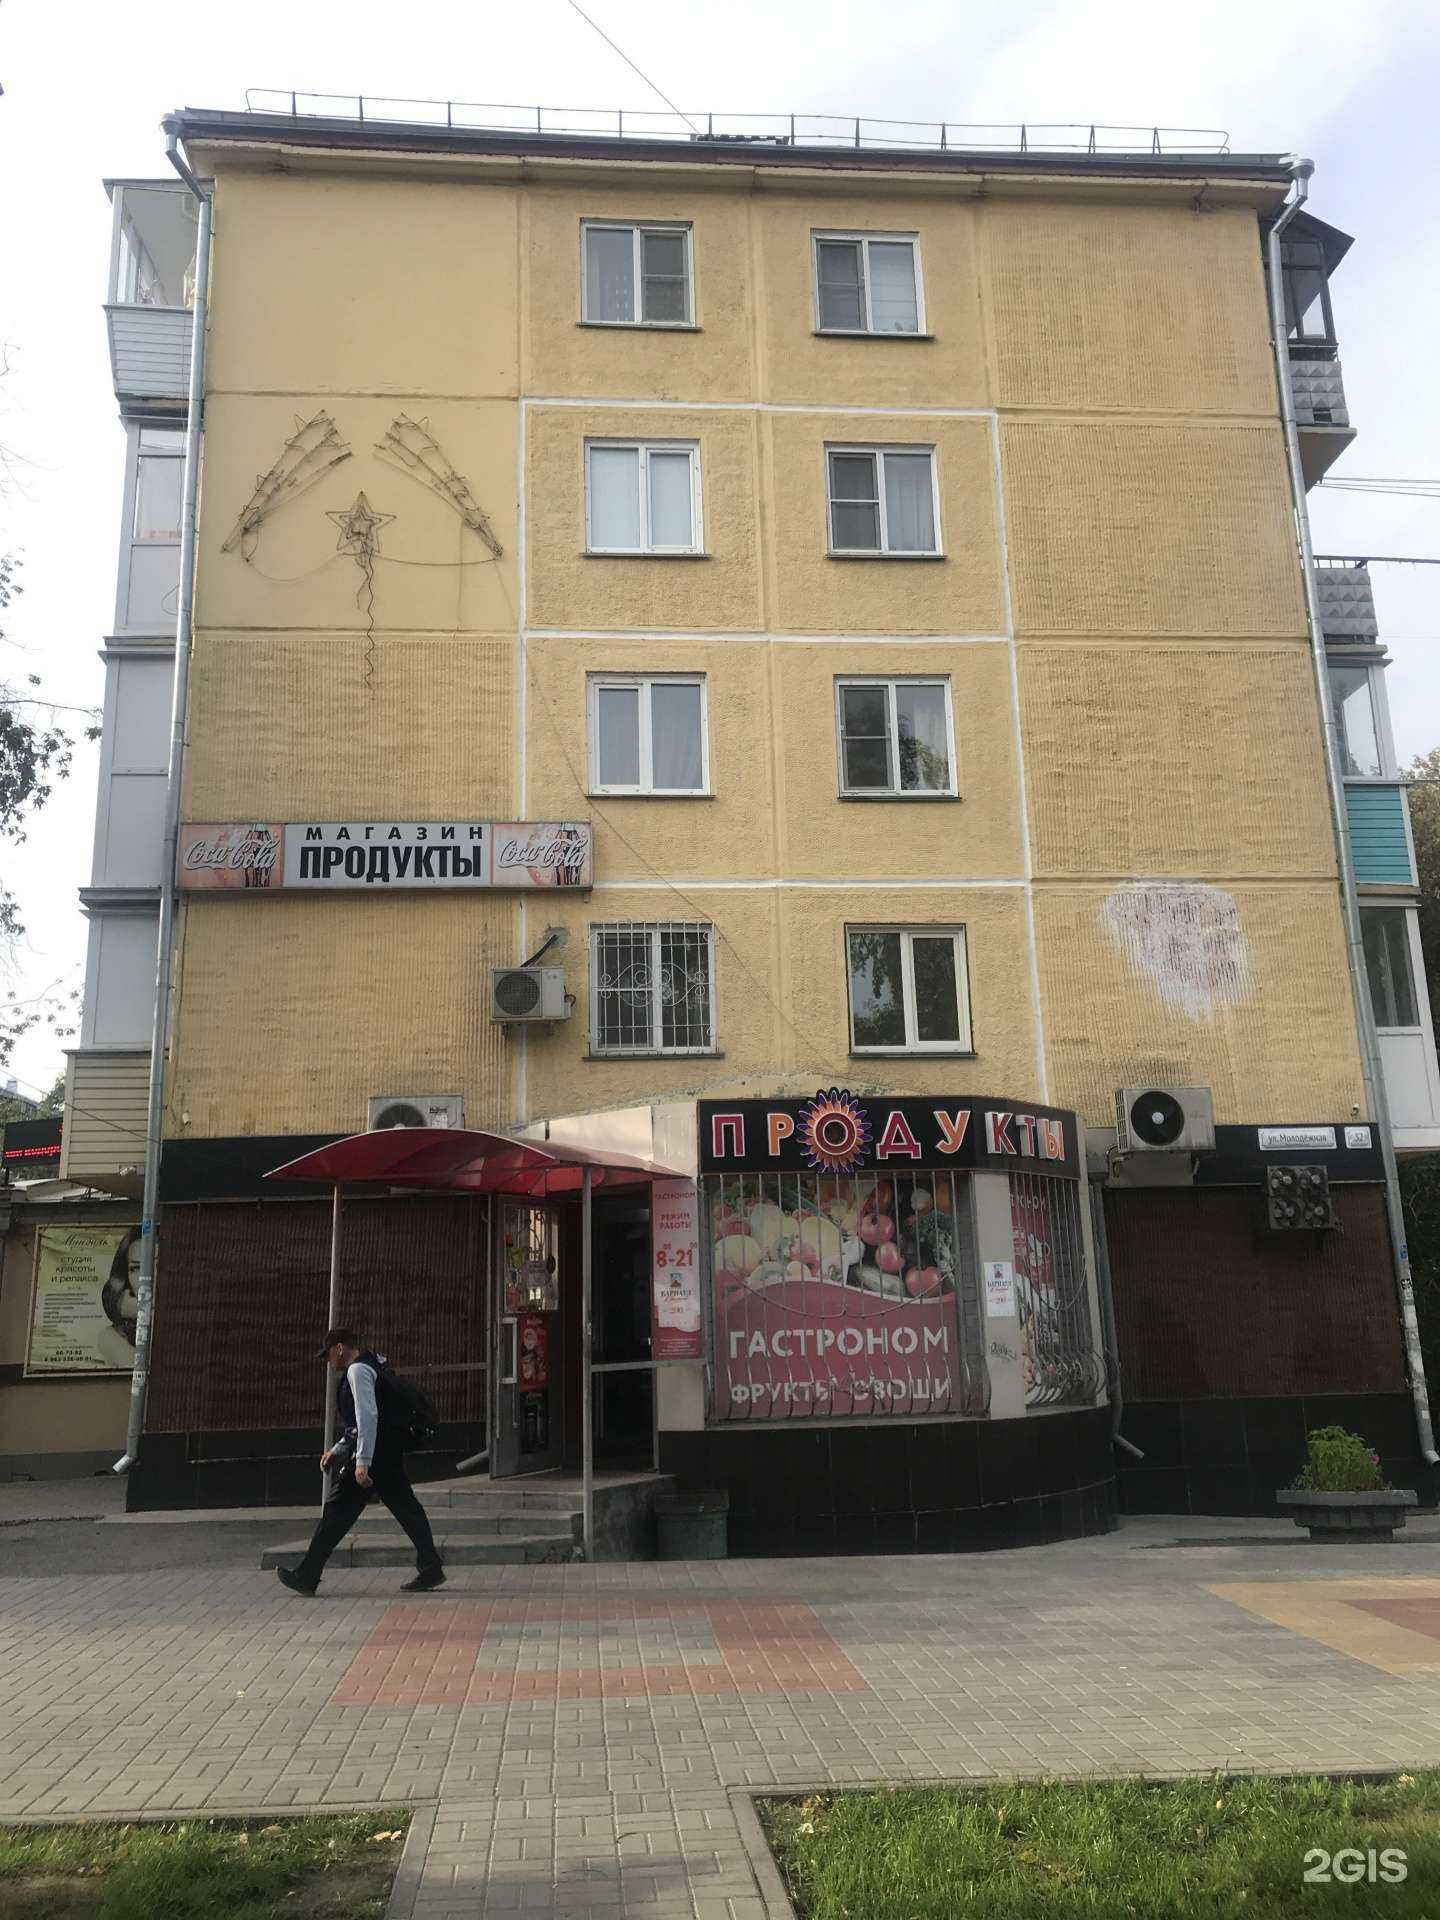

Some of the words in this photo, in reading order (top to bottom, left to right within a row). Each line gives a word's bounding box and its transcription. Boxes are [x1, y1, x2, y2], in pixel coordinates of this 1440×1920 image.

[305, 826, 483, 841] МАГАЗИН
[299, 845, 481, 883] ПРОДУКТЫ
[711, 1108, 1066, 1163] ПРОДУКТЫ
[659, 1221, 692, 1230] РАБОТЫ
[660, 1212, 690, 1221] РЕЖИМ
[729, 1326, 949, 1359] ГАСТРОНОМ
[731, 1380, 834, 1404] ФРУКТЫ
